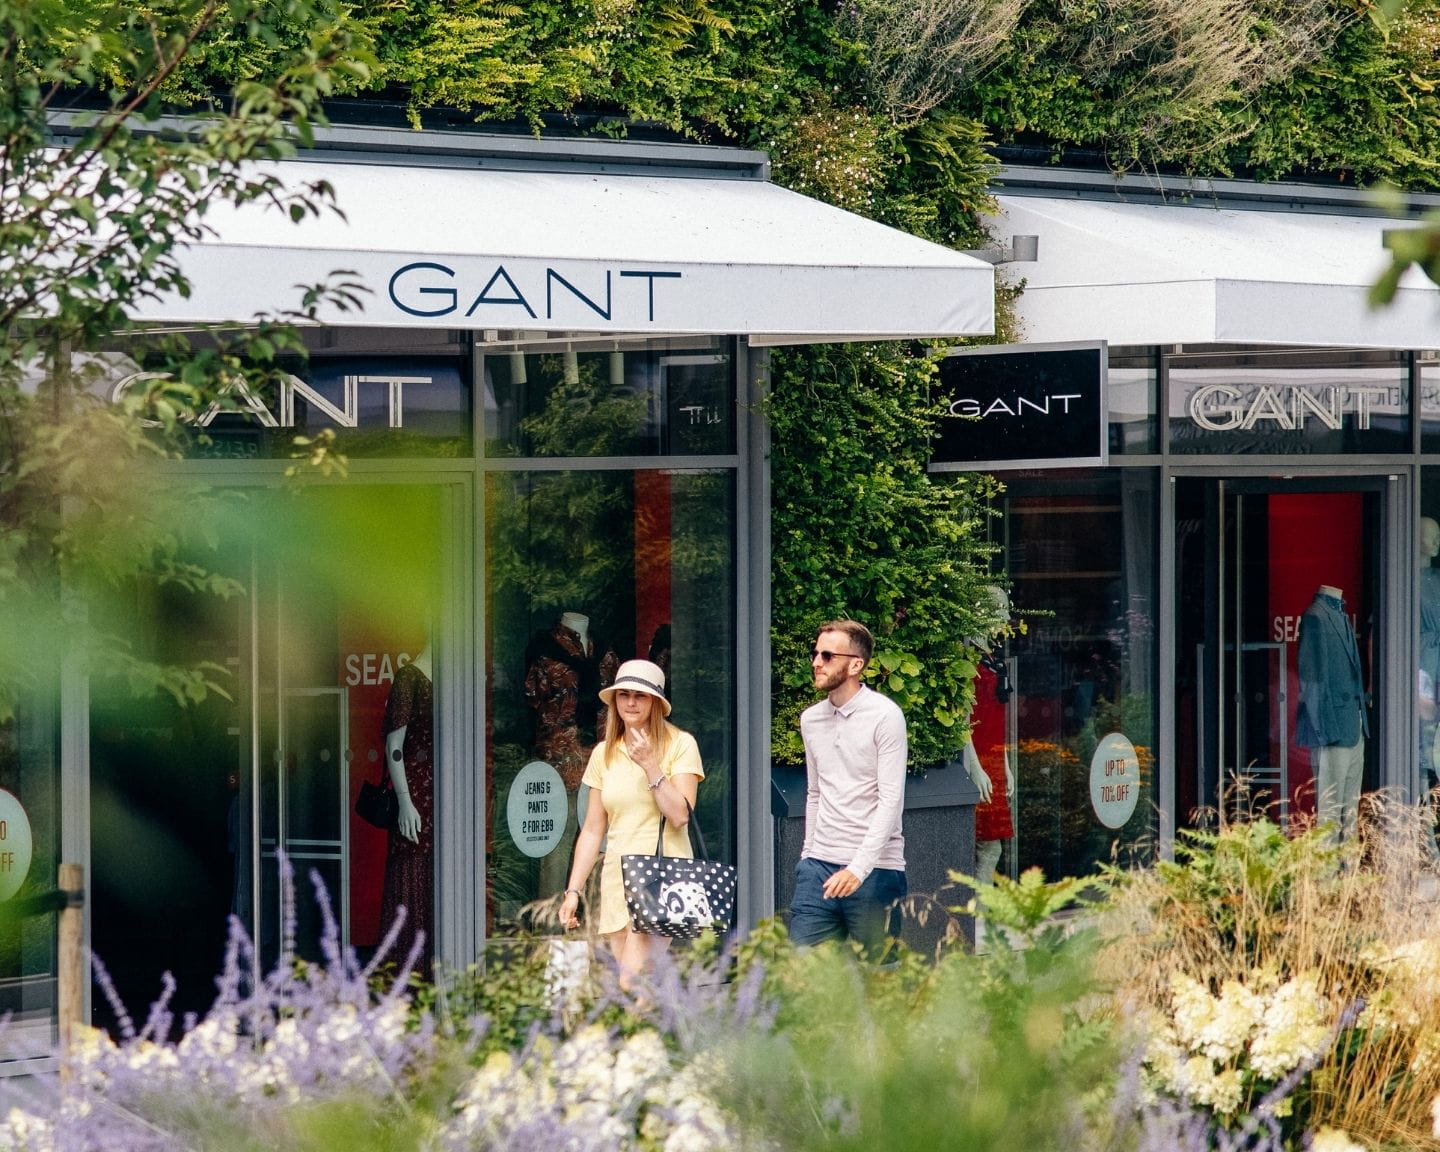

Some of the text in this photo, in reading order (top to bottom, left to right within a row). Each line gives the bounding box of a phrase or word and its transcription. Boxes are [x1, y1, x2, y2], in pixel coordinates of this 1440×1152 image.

[388, 262, 682, 322] GANT
[949, 394, 1082, 419] GANT
[1189, 384, 1389, 431] GANT
[1105, 759, 1126, 777] UP TO
[525, 782, 545, 795] JEANS
[1100, 785, 1130, 803] 70% OFF
[528, 801, 548, 814] PANTS
[522, 821, 527, 834] 2
[528, 821, 540, 833] FOR
